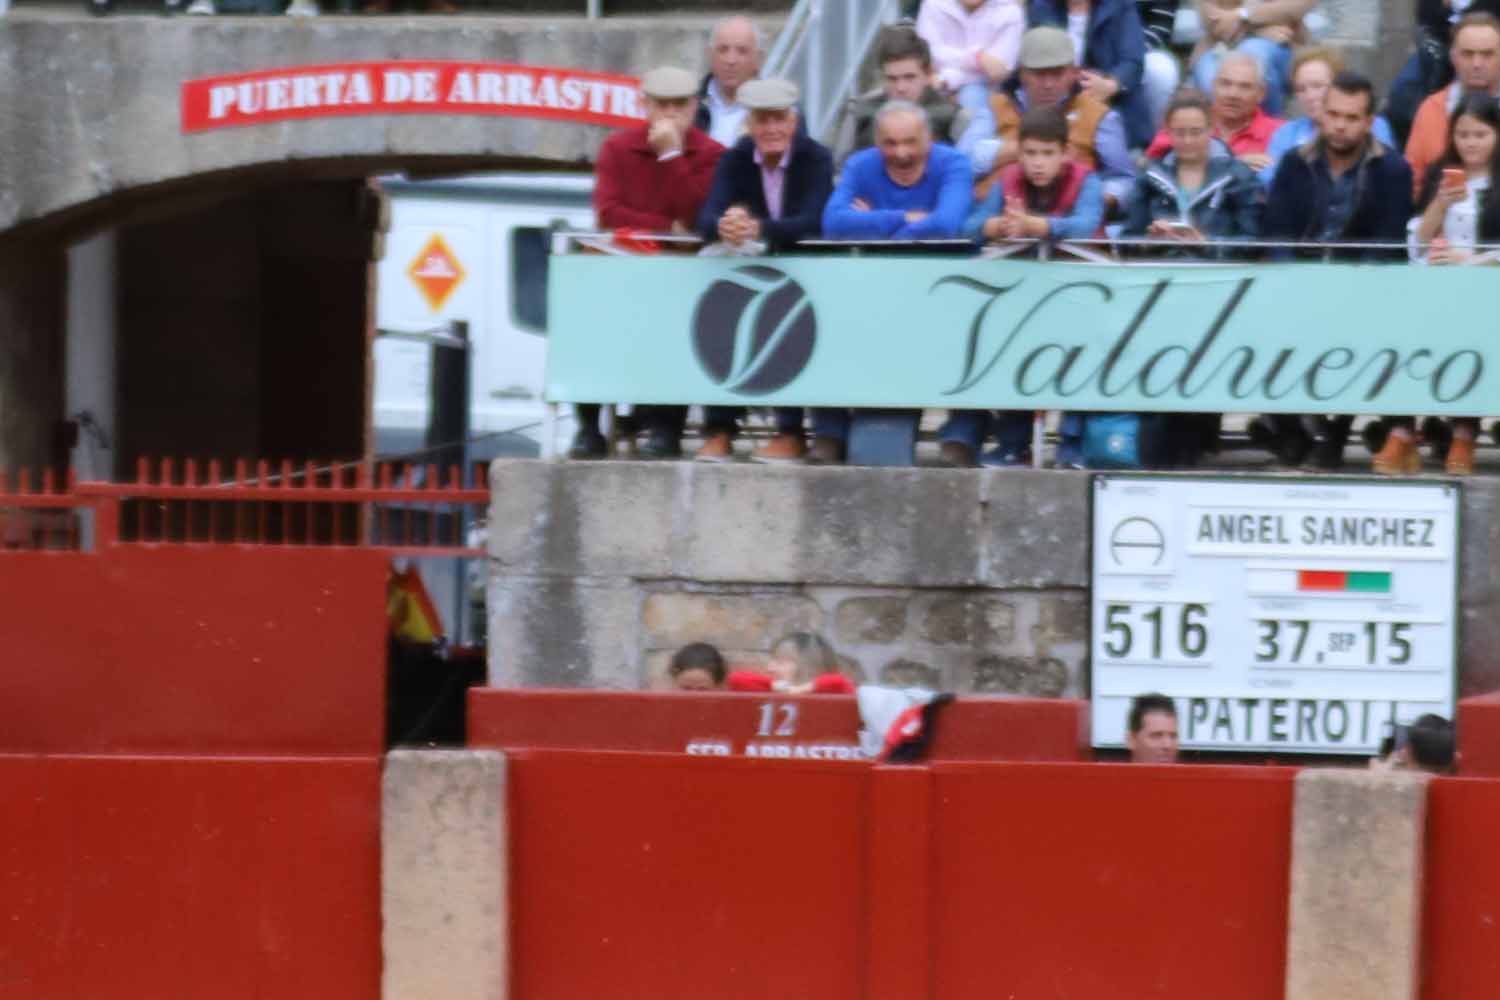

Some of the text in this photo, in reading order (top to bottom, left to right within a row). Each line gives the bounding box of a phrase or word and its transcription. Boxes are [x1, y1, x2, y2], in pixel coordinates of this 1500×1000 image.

[208, 70, 648, 119] PUERTA DE ARRASTR
[929, 274, 1485, 403] Valduero
[1197, 513, 1436, 548] ANGEL SANCHEZ
[1102, 602, 1209, 660] 516
[756, 702, 798, 737] 12
